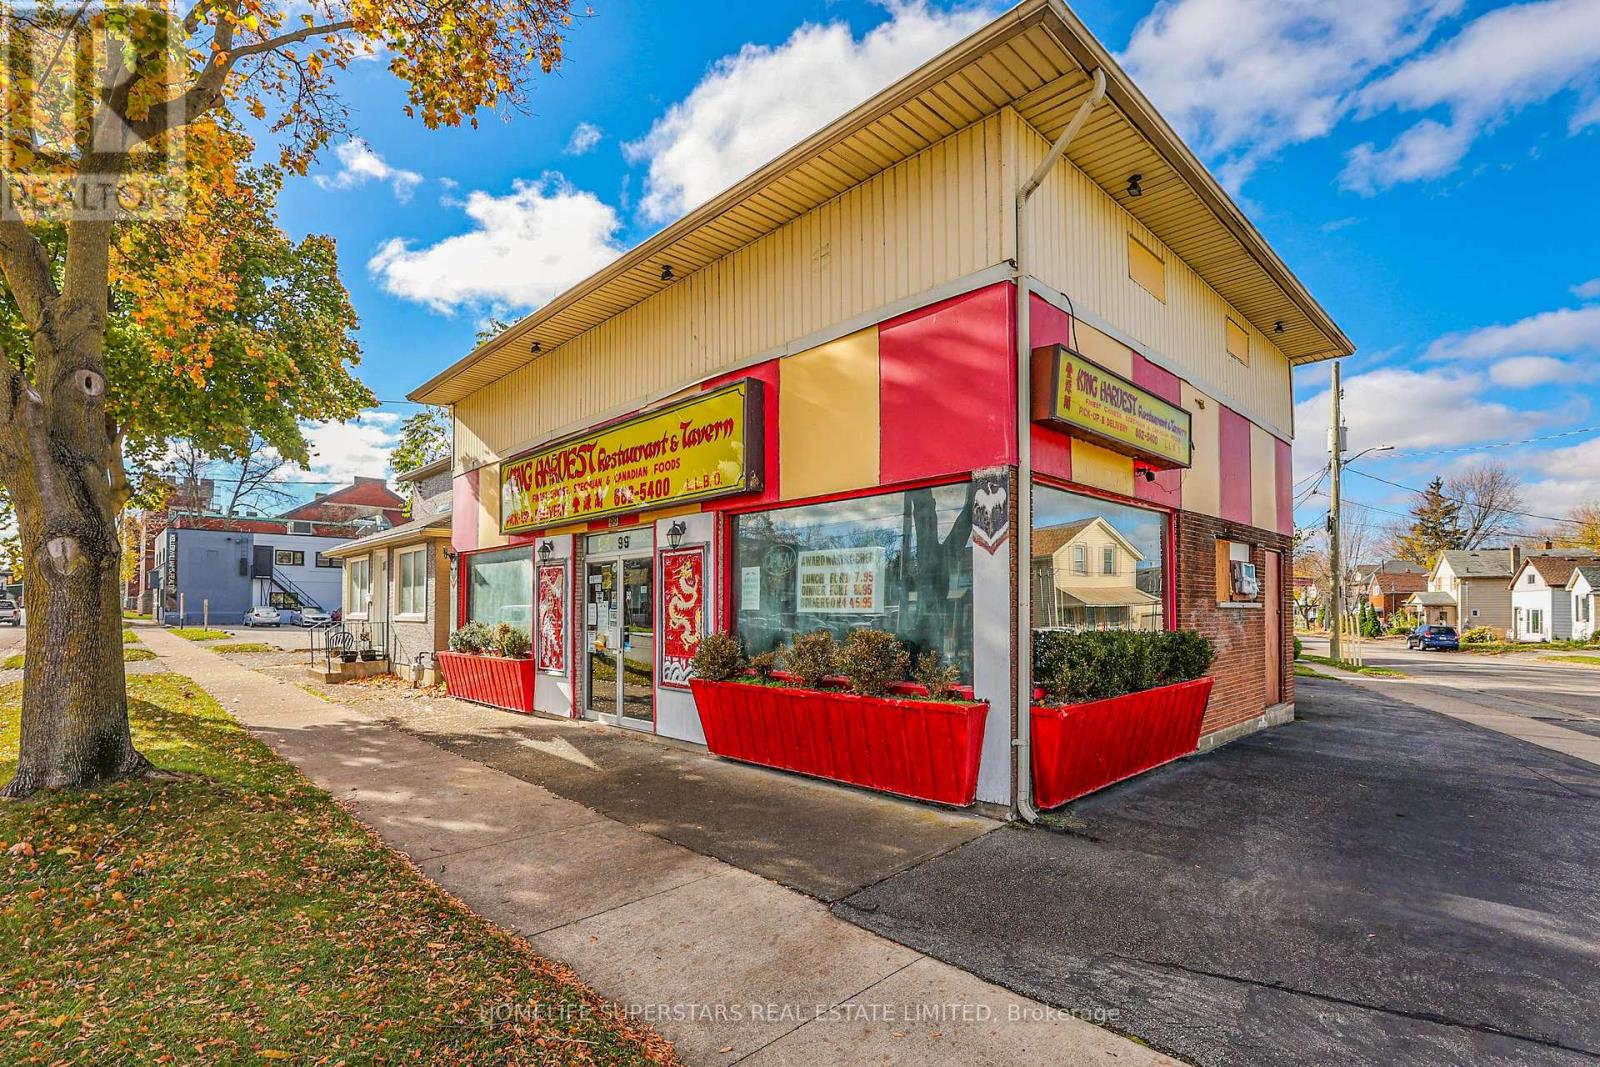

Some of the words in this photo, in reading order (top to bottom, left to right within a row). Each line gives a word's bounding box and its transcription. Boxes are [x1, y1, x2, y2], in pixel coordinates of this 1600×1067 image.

[1076, 367, 1098, 398] KING
[1100, 380, 1138, 416] HARVEST
[598, 430, 669, 473] Restaurant
[670, 434, 679, 453] &
[680, 417, 734, 450] Tavern
[654, 458, 681, 474] FOODS
[617, 535, 630, 550] 99
[801, 554, 825, 567] AWARD
[802, 573, 825, 585] LUNCH
[855, 571, 874, 583] 7.95
